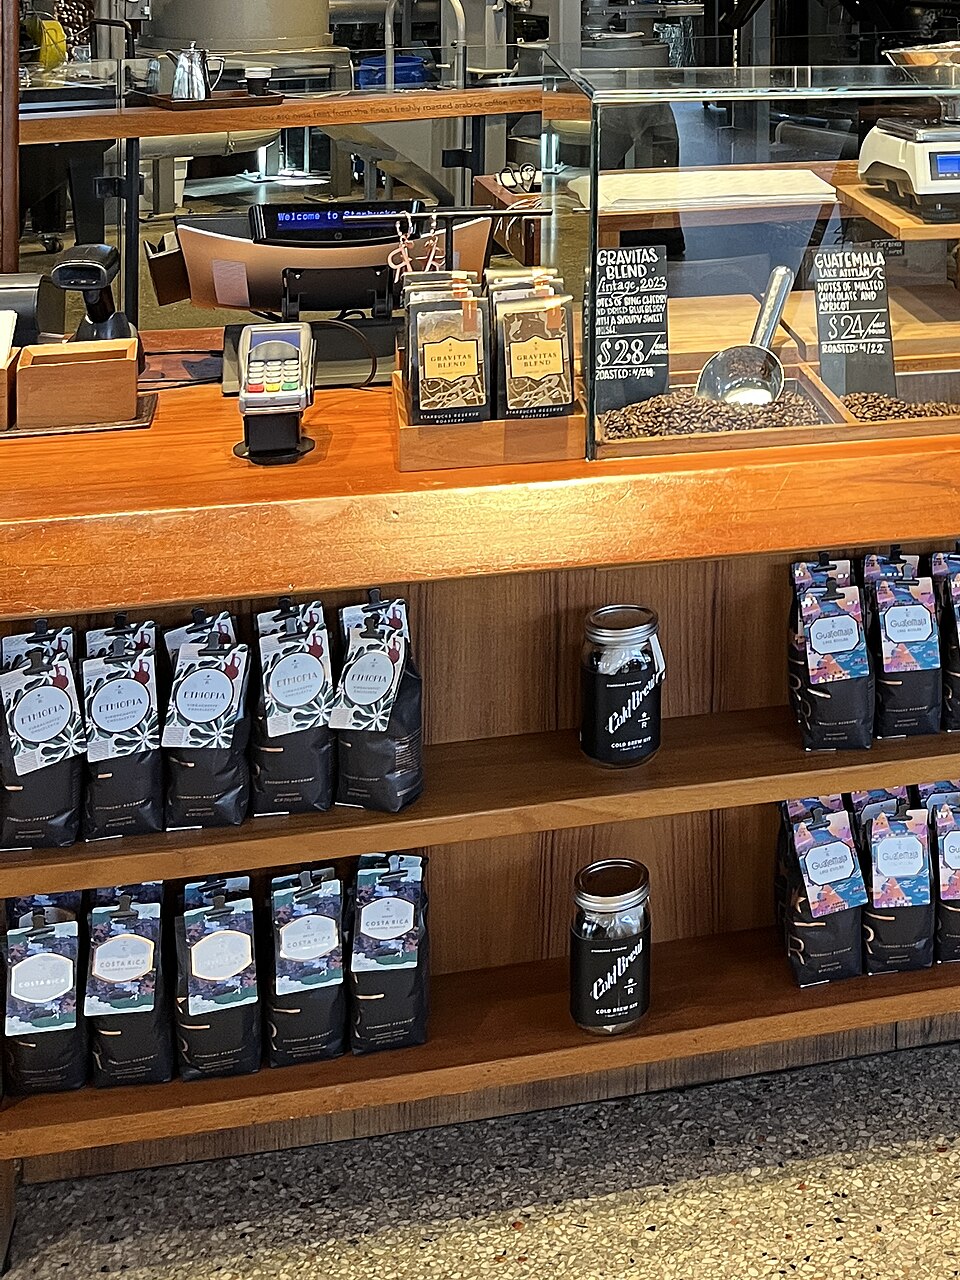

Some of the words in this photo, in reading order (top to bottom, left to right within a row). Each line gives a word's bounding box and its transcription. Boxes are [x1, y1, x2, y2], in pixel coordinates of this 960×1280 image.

[332, 110, 351, 118] from
[370, 106, 393, 114] finest
[394, 105, 421, 113] freshly
[422, 102, 452, 111] roasted
[454, 101, 483, 110] arabica
[484, 99, 508, 107] coffee
[278, 212, 320, 221] Welcome
[327, 211, 338, 219] to
[597, 248, 658, 266] GRAVITAS
[815, 252, 885, 268] GUATEMALA
[606, 264, 647, 280] BLEND
[819, 269, 838, 278] LAKE
[640, 276, 667, 290] 2023
[818, 282, 841, 292] NOTES
[843, 282, 851, 291] OF
[854, 281, 884, 290] MALTED
[597, 298, 613, 308] OTES
[624, 296, 641, 306] BING
[642, 294, 668, 304] CHERRY
[819, 292, 857, 301] CHOCOLATE
[861, 291, 876, 300] AND
[607, 307, 628, 315] DRIED
[629, 304, 666, 314] BLUEBERRY
[819, 301, 849, 311] APRICOT
[822, 344, 858, 354] ROASTED:
[860, 343, 885, 354] 4/22
[430, 354, 472, 362] GRAVITAS
[516, 352, 557, 361] GRAVITAS
[437, 361, 465, 369] BLEND
[276, 672, 318, 688] ETHIOPIA
[351, 674, 387, 684] ETHIOPIA
[183, 691, 226, 700] ETHIOPIA
[98, 697, 143, 712] ETHIOPIA
[20, 704, 65, 725] ETHIOPIA
[604, 698, 631, 734] Cold
[611, 741, 626, 749] COLD
[628, 739, 643, 747] BREW
[366, 919, 389, 927] COSTA
[100, 960, 128, 968] COSTA
[129, 958, 146, 967] RICA
[590, 965, 617, 1000] Cold
[617, 938, 643, 977] Brew
[18, 979, 45, 989] COSTA
[47, 978, 66, 986] RICA
[596, 1007, 611, 1015] COLD
[613, 1005, 628, 1013] BREW
